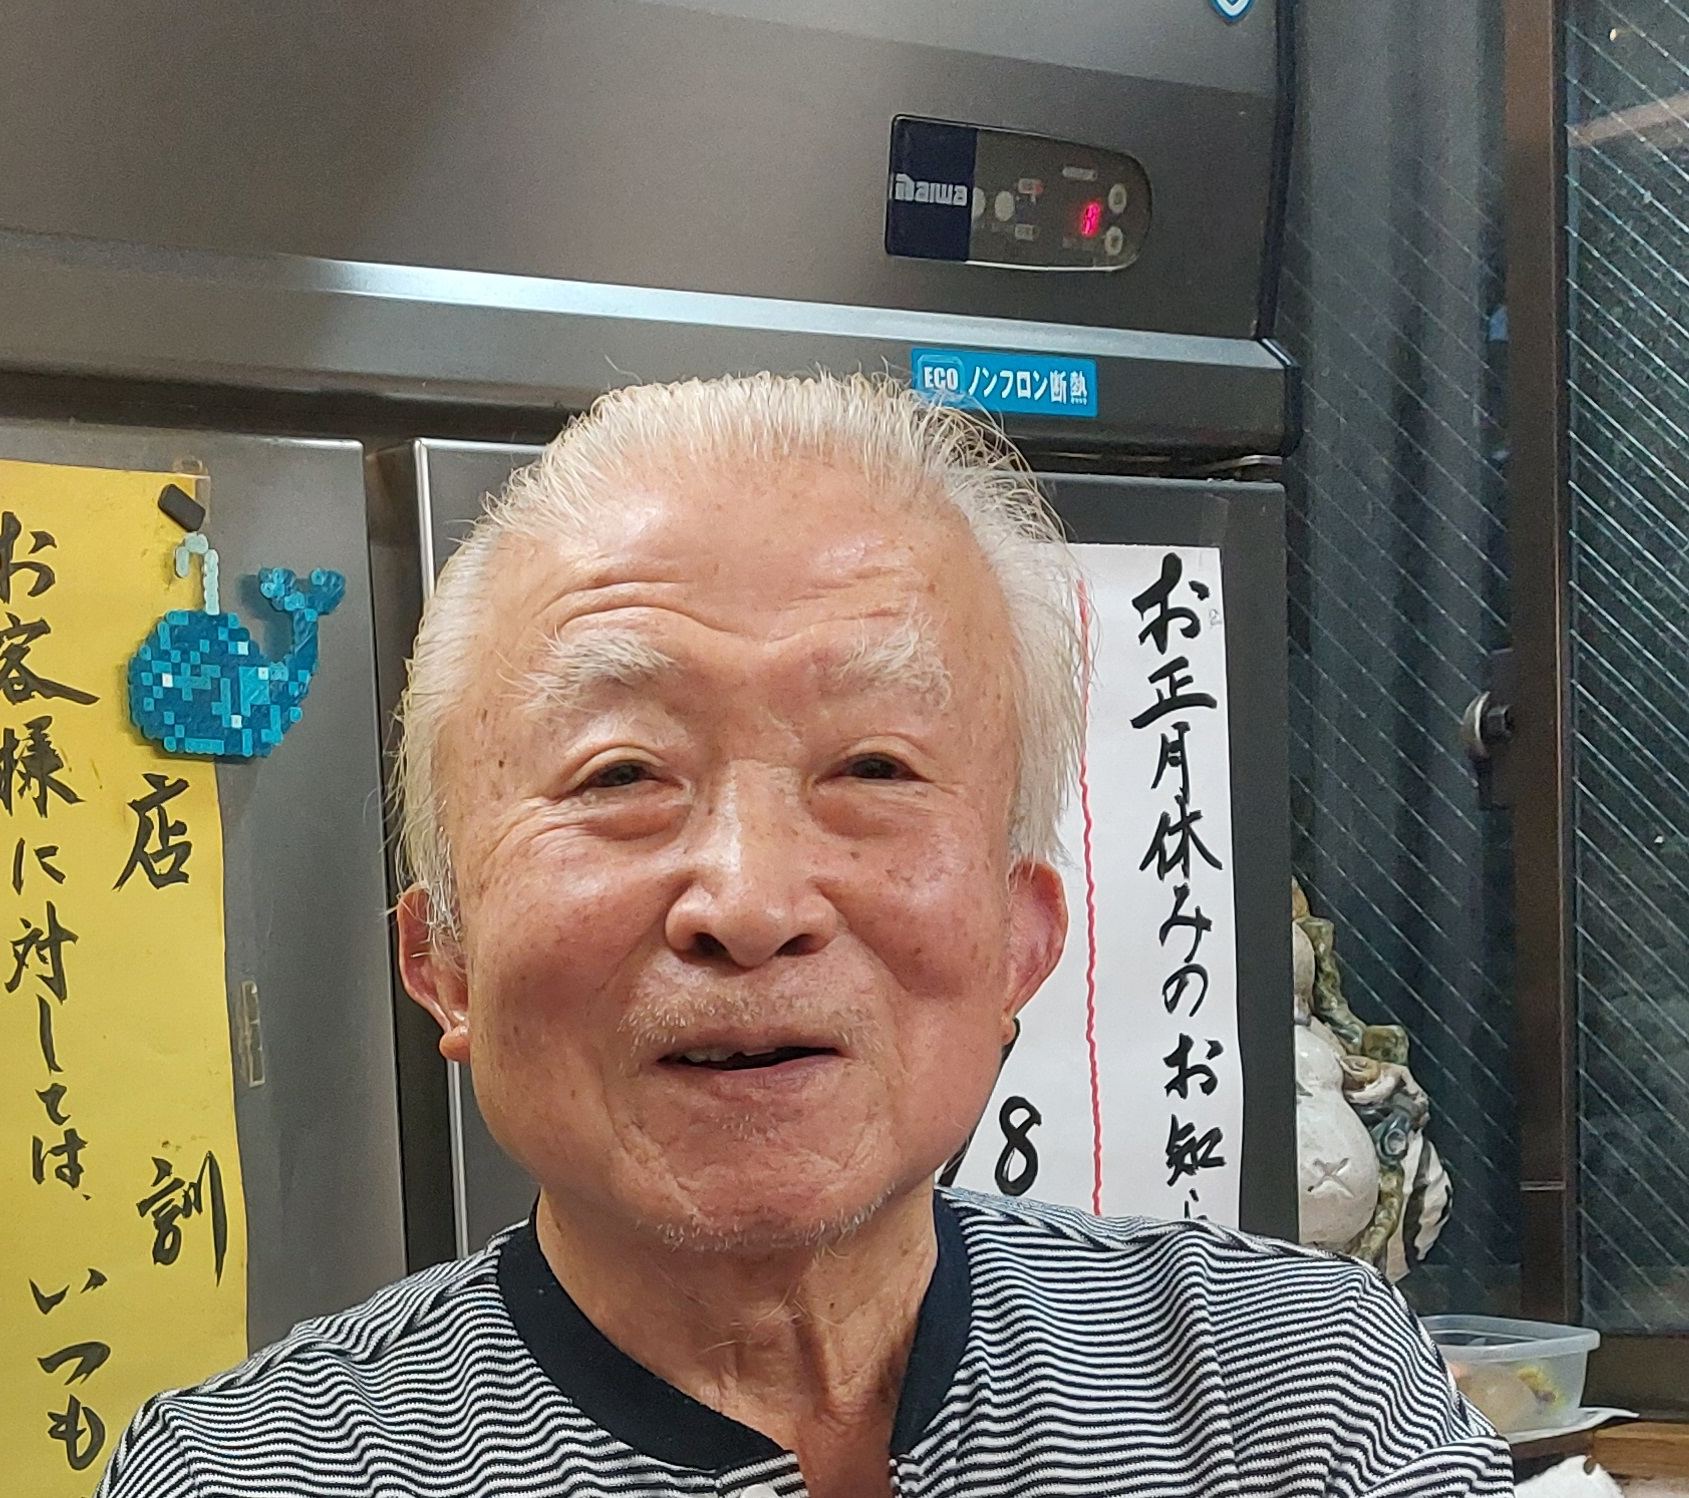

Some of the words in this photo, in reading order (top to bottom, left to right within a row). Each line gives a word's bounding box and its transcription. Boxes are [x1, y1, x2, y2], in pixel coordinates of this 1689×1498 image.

[924, 366, 959, 391] ECO
[968, 366, 1088, 405] ノンフロン断熱
